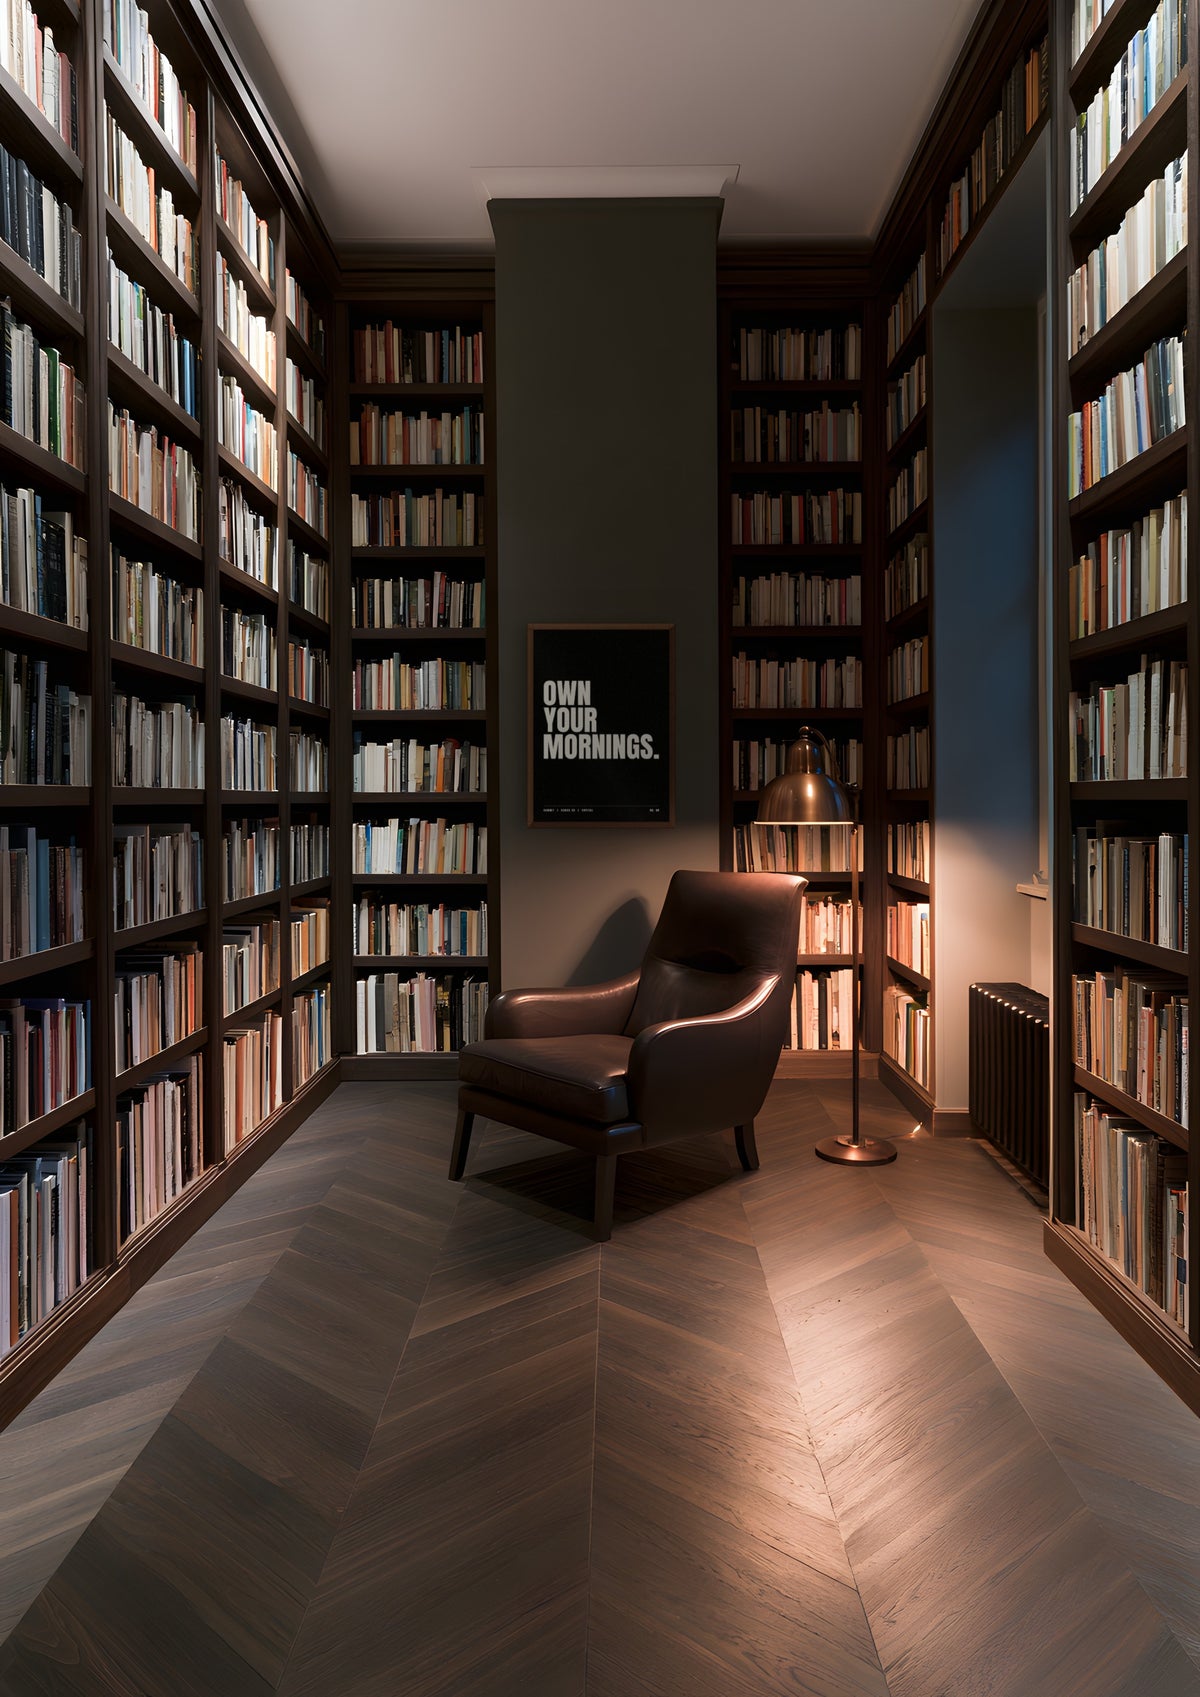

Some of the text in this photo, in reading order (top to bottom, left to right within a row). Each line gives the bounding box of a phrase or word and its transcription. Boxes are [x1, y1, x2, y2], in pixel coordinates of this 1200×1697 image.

[543, 680, 591, 706] OWN
[543, 707, 598, 733] YOUR
[543, 733, 660, 760] MORNINGS.
